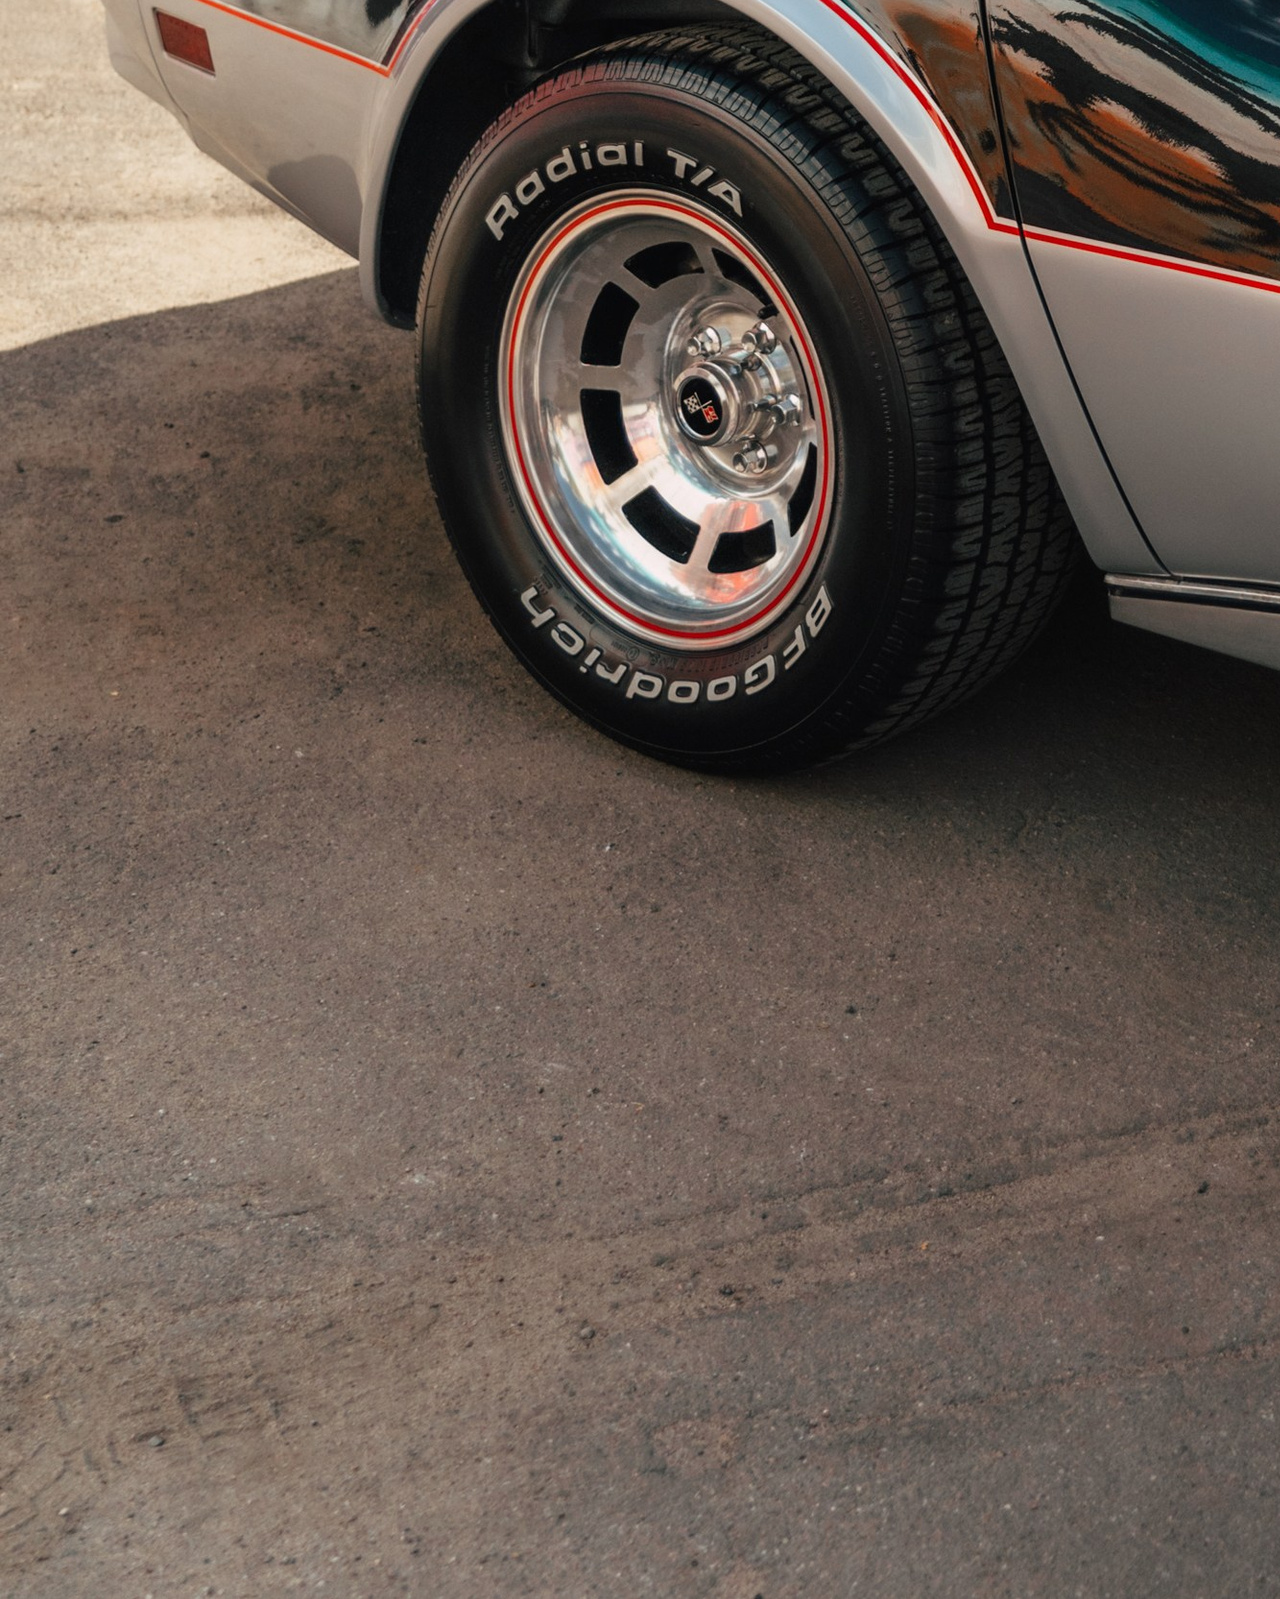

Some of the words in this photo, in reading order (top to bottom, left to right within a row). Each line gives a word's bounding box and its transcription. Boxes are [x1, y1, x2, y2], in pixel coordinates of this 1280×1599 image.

[484, 140, 645, 242] Radial
[666, 147, 744, 218] T/A
[520, 584, 834, 704] BFGoodrich
